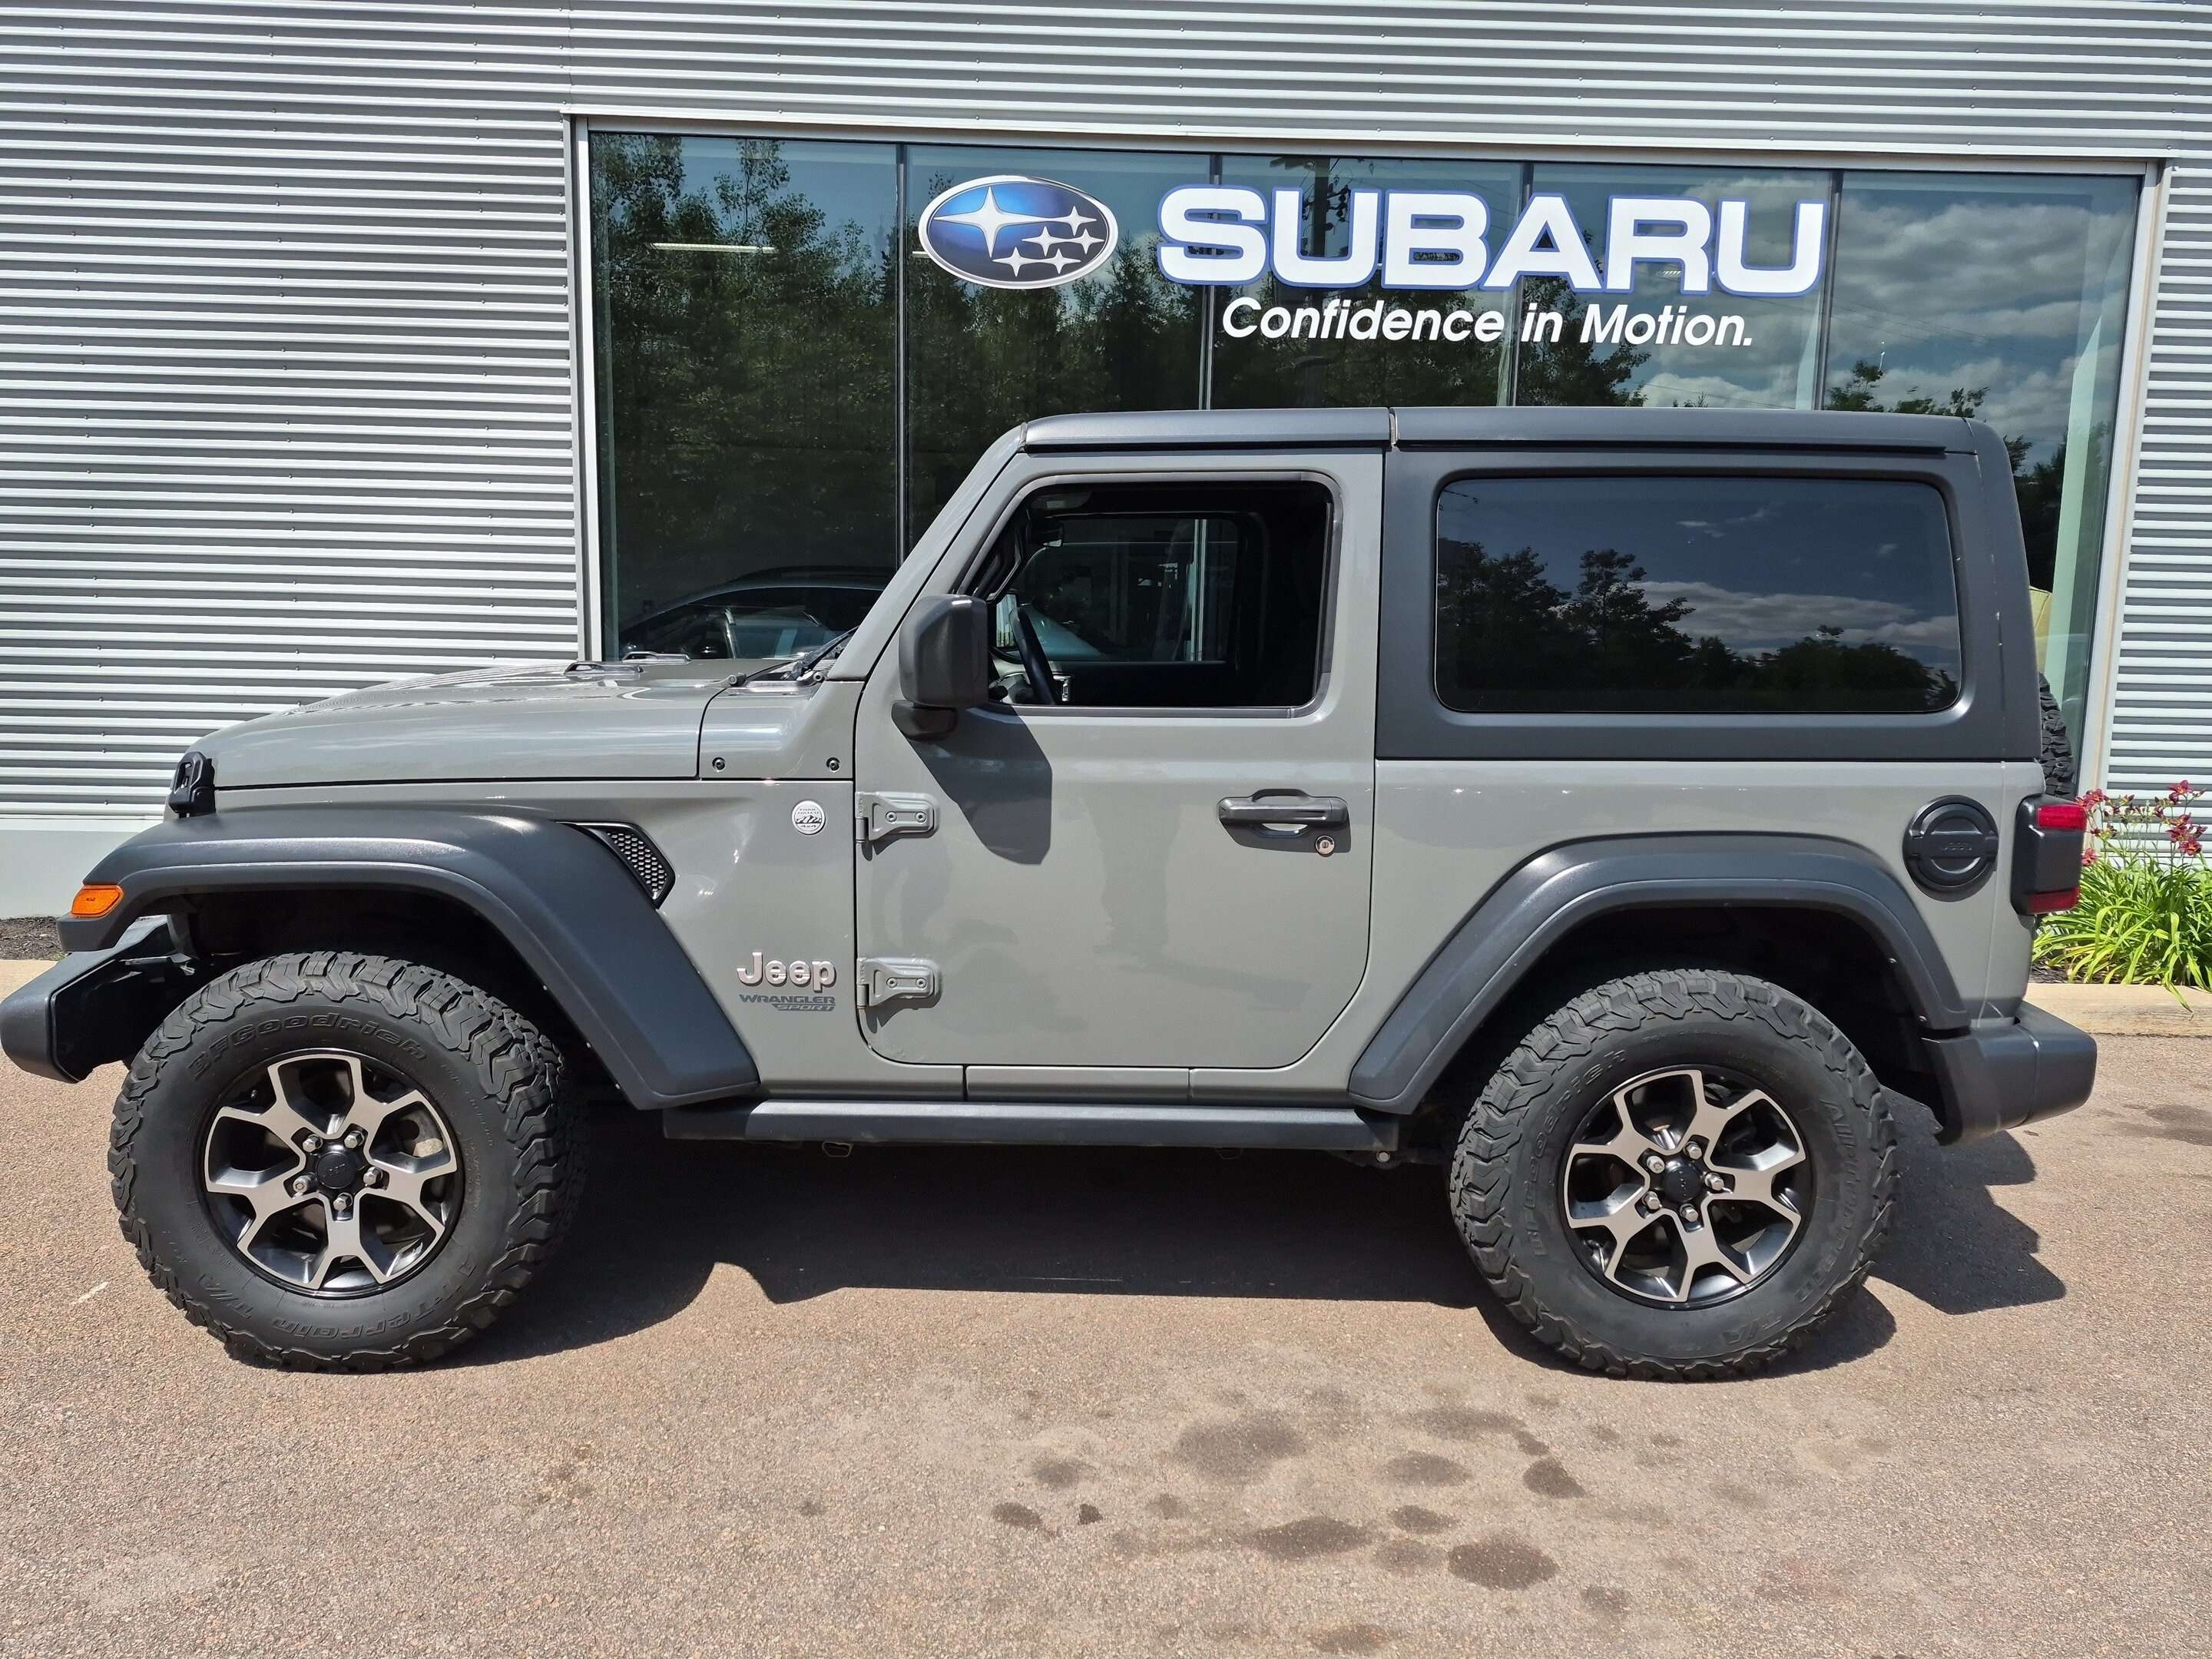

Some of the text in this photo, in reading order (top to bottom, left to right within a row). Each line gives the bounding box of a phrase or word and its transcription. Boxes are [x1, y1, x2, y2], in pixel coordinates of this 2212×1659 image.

[1157, 184, 1829, 297] SUBARU
[1222, 296, 1752, 346] Confidence in Motion.
[737, 951, 836, 993] Jeep
[739, 994, 836, 1004] WRANGLER
